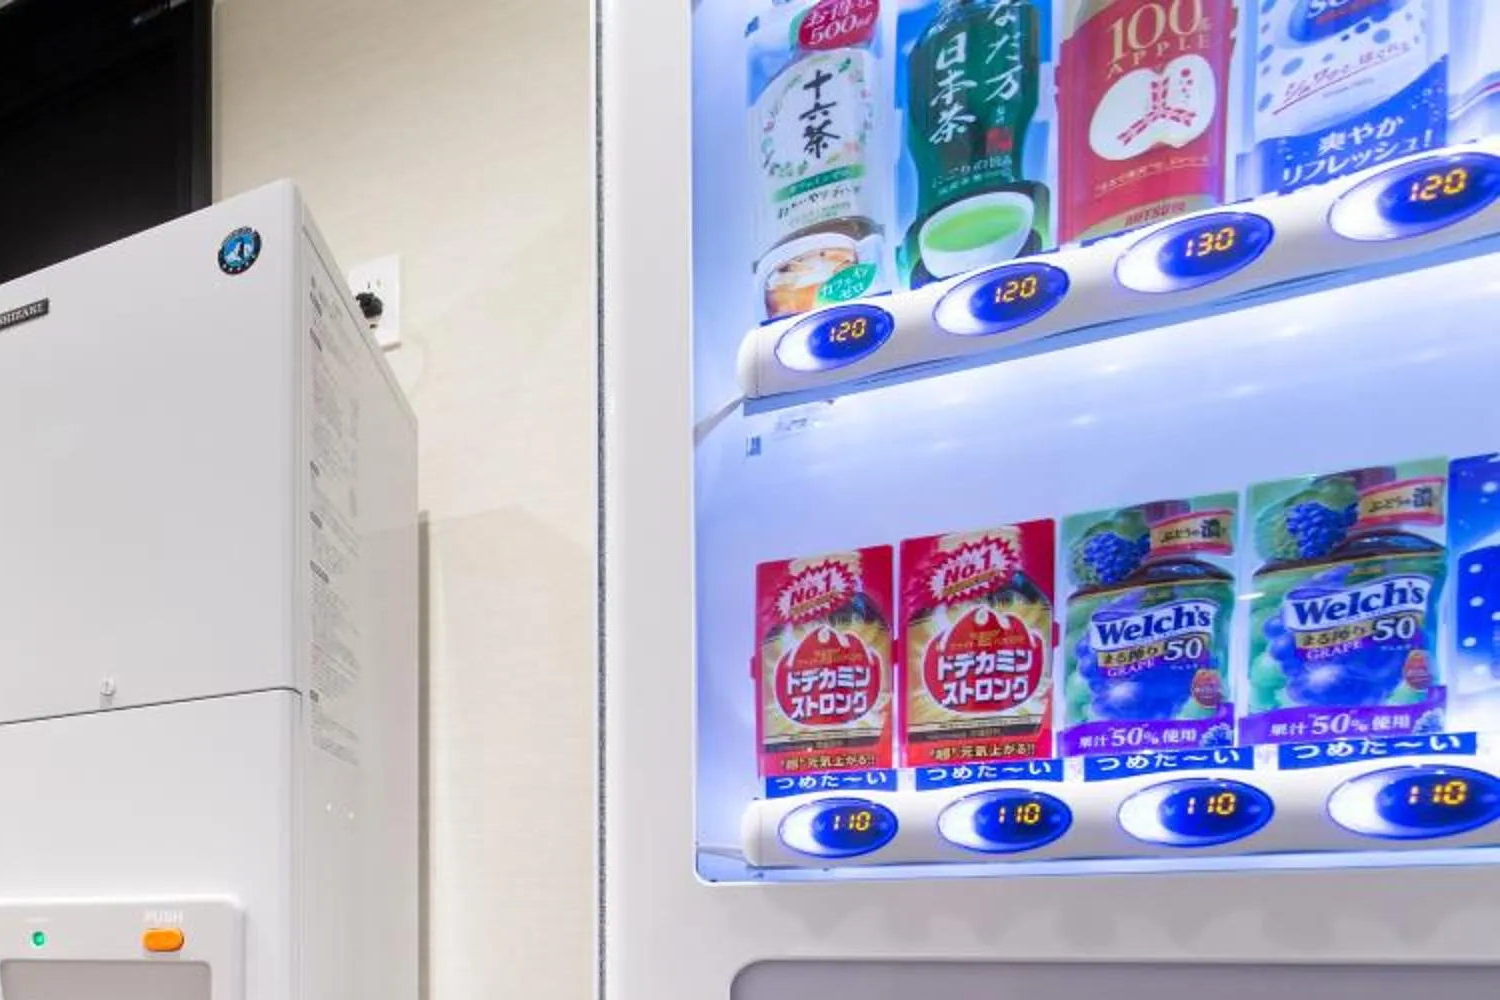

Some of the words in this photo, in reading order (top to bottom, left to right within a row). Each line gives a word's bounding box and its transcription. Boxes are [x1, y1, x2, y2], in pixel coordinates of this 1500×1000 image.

[929, 31, 977, 144] 日本茶
[799, 69, 841, 159] 十六茶
[1317, 116, 1404, 156] 爽やか
[1409, 167, 1467, 201] 120
[1185, 227, 1236, 257] 130
[994, 276, 1037, 304] 120
[830, 318, 867, 342] 120
[1292, 581, 1425, 626] Welch's
[1095, 606, 1211, 646] Welch's
[1370, 616, 1416, 642] 50
[1163, 637, 1203, 662] 50
[1307, 640, 1362, 660] GRAPE
[937, 649, 1033, 681] ドデカミン
[1108, 659, 1155, 678] GRAPE
[787, 666, 871, 695] ドデカミン
[941, 677, 1029, 706] ストロング
[791, 691, 868, 720] ストロング
[1187, 792, 1236, 815] 110
[1408, 780, 1467, 805] 110
[833, 812, 871, 831] 110
[999, 803, 1041, 825] 110
